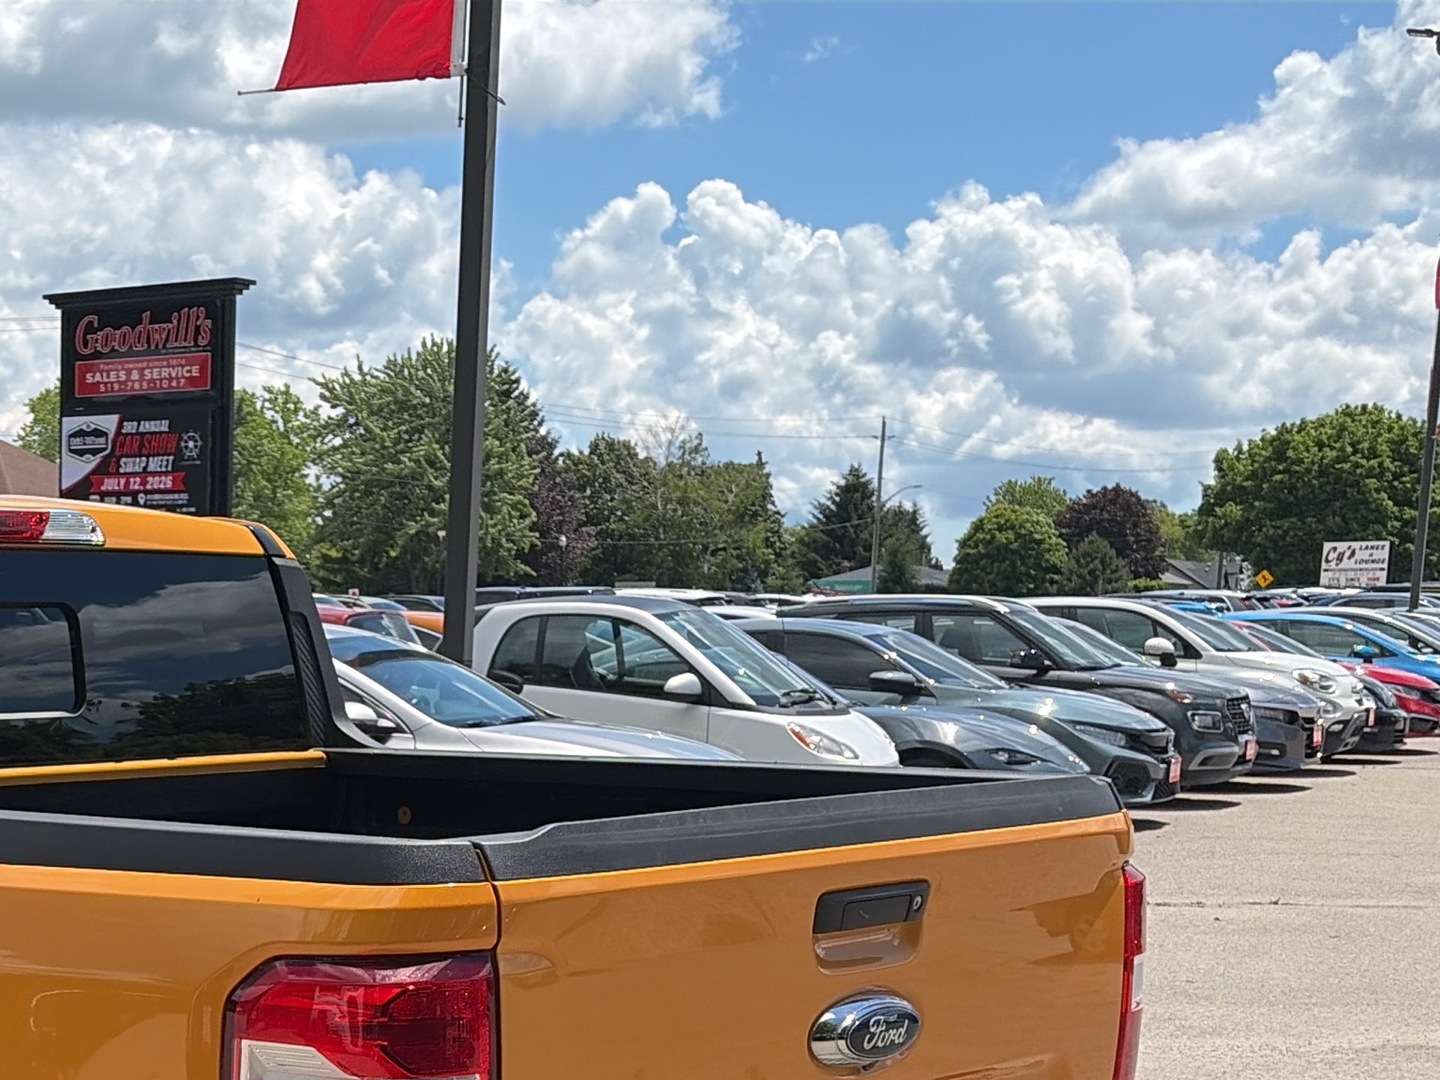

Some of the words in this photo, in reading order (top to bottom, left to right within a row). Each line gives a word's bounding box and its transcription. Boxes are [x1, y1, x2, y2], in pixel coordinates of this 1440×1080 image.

[75, 306, 212, 355] Goodwill's
[85, 371, 127, 383] SALES
[130, 370, 140, 380] &
[143, 365, 200, 379] SERVICE
[99, 379, 186, 392] 519-765-1047
[116, 435, 140, 456] CAR
[142, 432, 180, 453] SHOW
[119, 457, 148, 473] SWAP
[147, 456, 174, 471] MEET
[101, 478, 125, 490] JULY
[129, 478, 143, 490] 12,
[1324, 544, 1357, 567] Cy's
[863, 1015, 909, 1050] Ford
